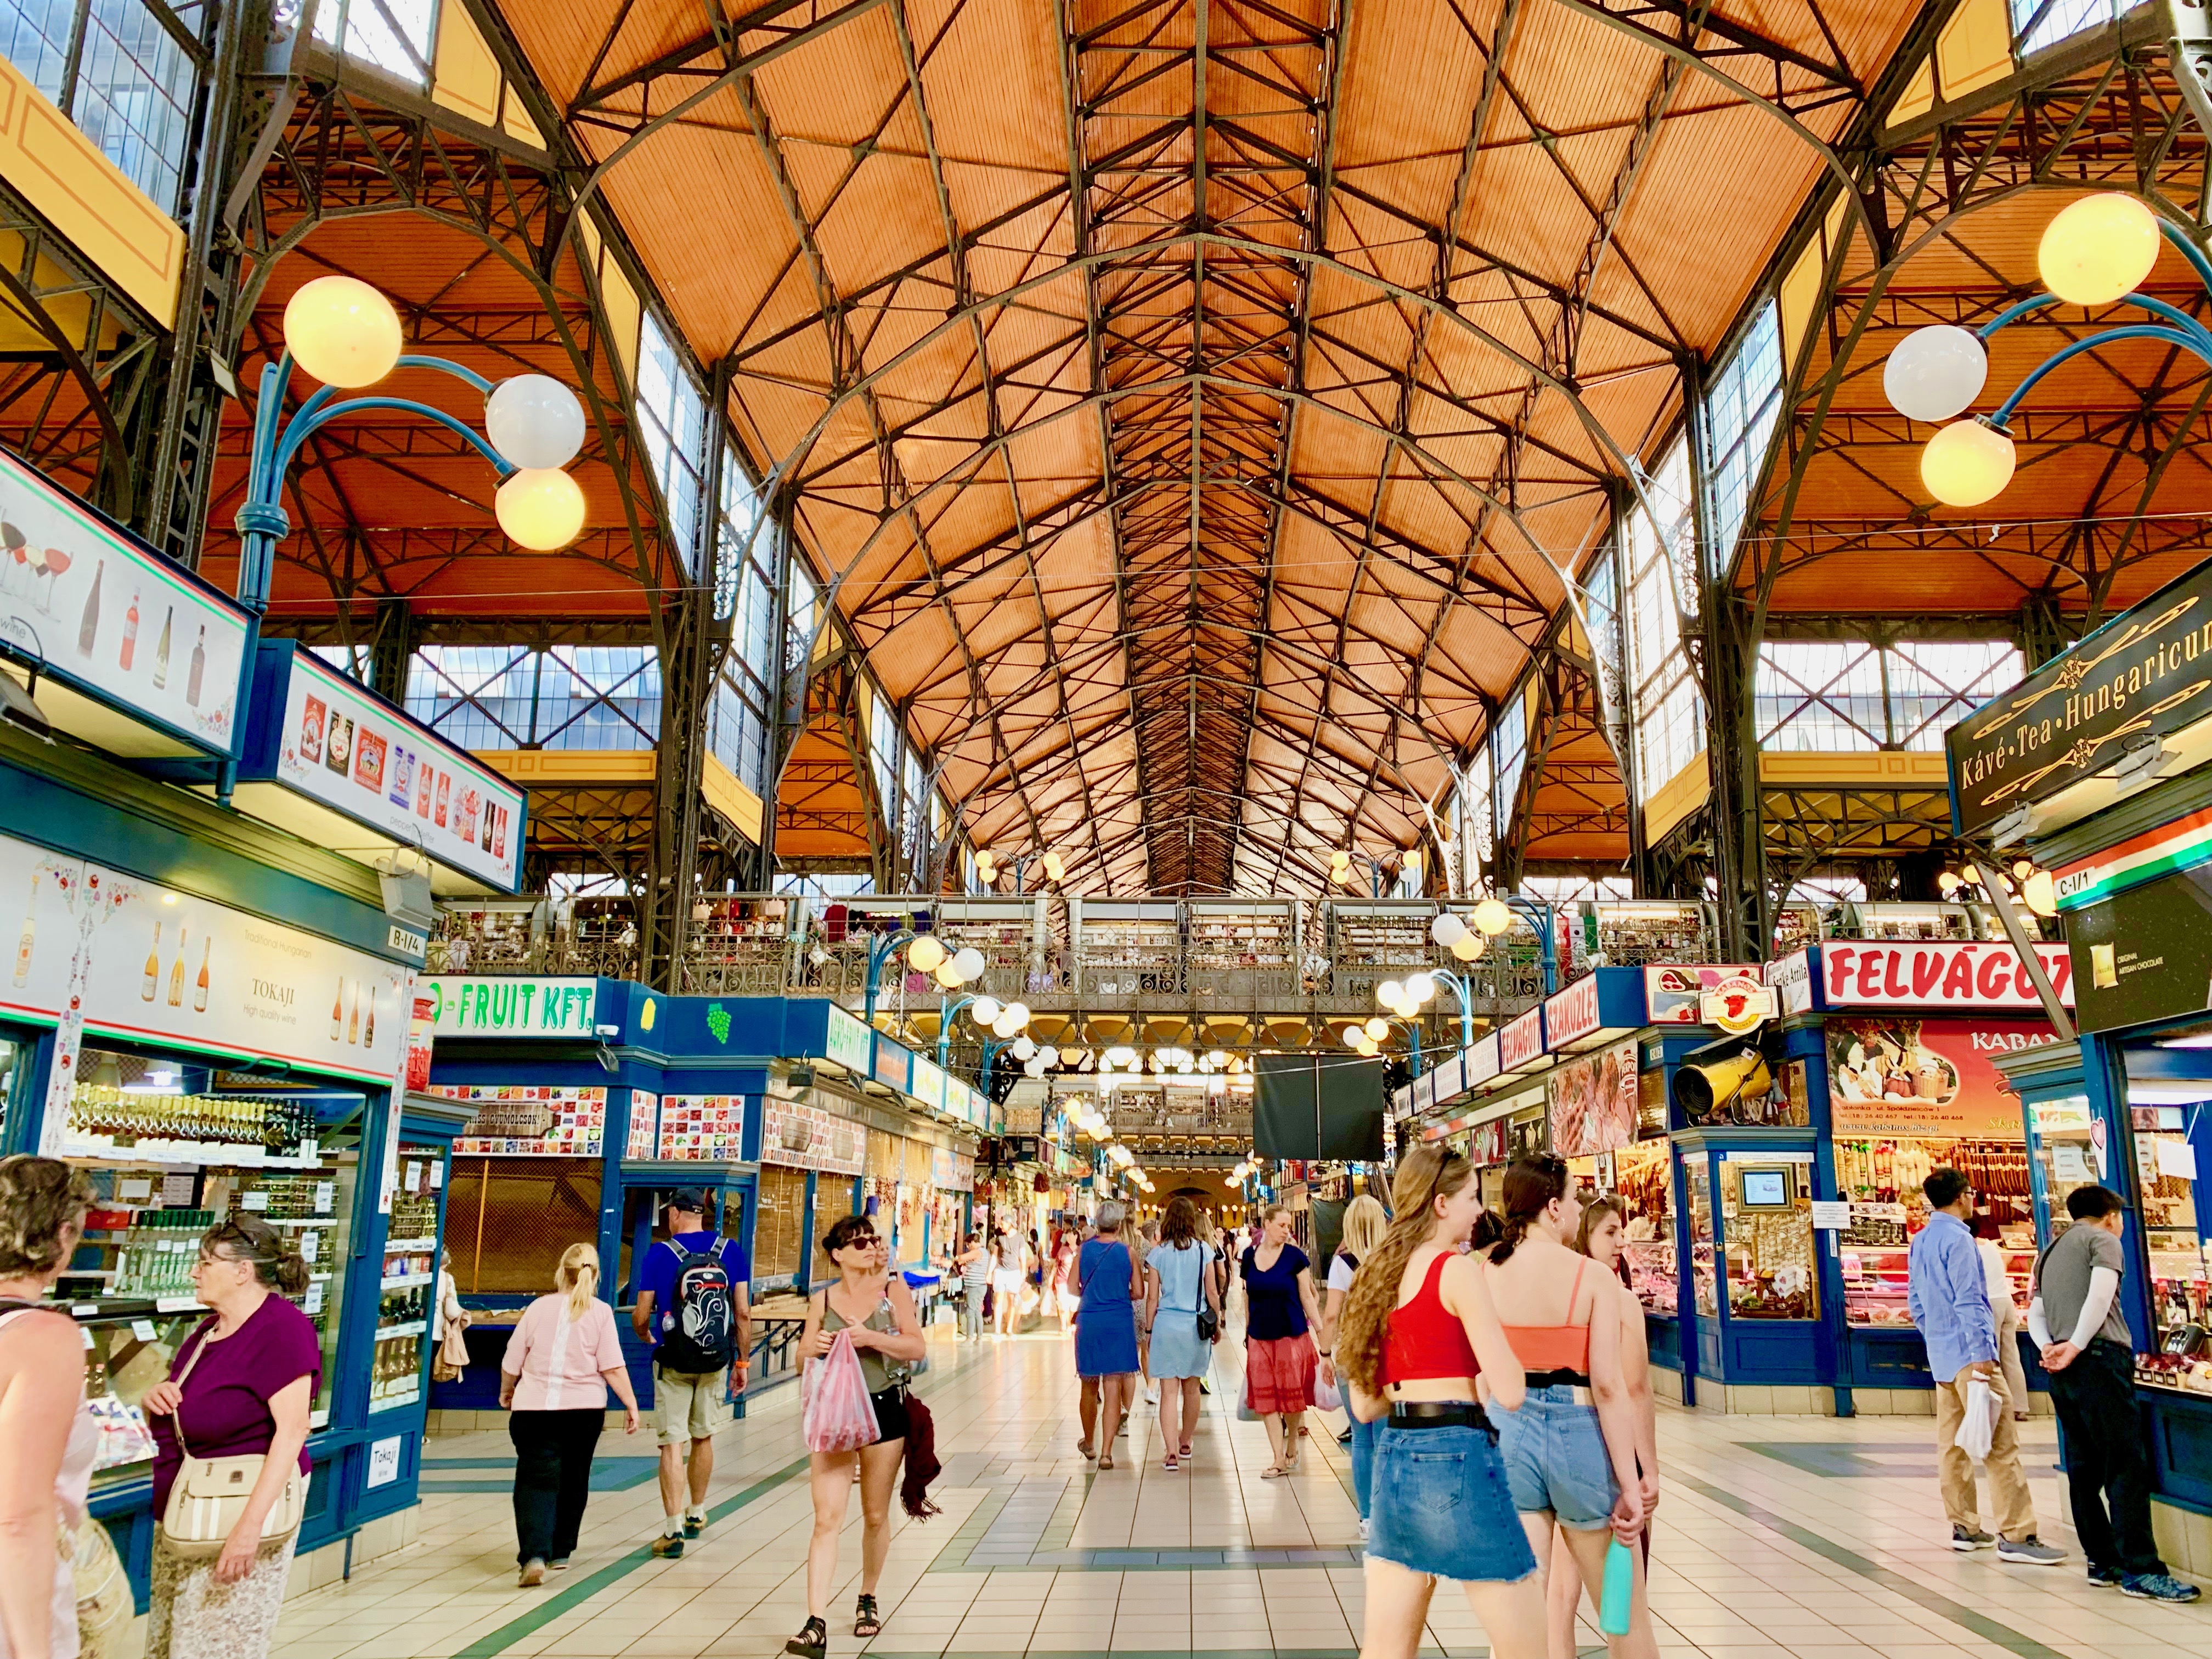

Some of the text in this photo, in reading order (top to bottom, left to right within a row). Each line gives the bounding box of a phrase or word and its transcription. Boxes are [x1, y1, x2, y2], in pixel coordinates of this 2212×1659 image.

[1962, 736, 2006, 790] Kávé
[2017, 721, 2051, 757] Tea
[245, 929, 312, 959] Traditional Hungarian
[2117, 952, 2138, 964] ORIGINAL
[2119, 956, 2164, 975] ARTISAN CHOCOLATE
[1791, 963, 1808, 985] Attila
[252, 978, 295, 1008] TOKAJI
[243, 1003, 297, 1025] High quality wine
[540, 987, 593, 1030] KFT.
[1502, 1014, 1541, 1065] FELVÁGOTT
[374, 1446, 397, 1464] Tokaji
